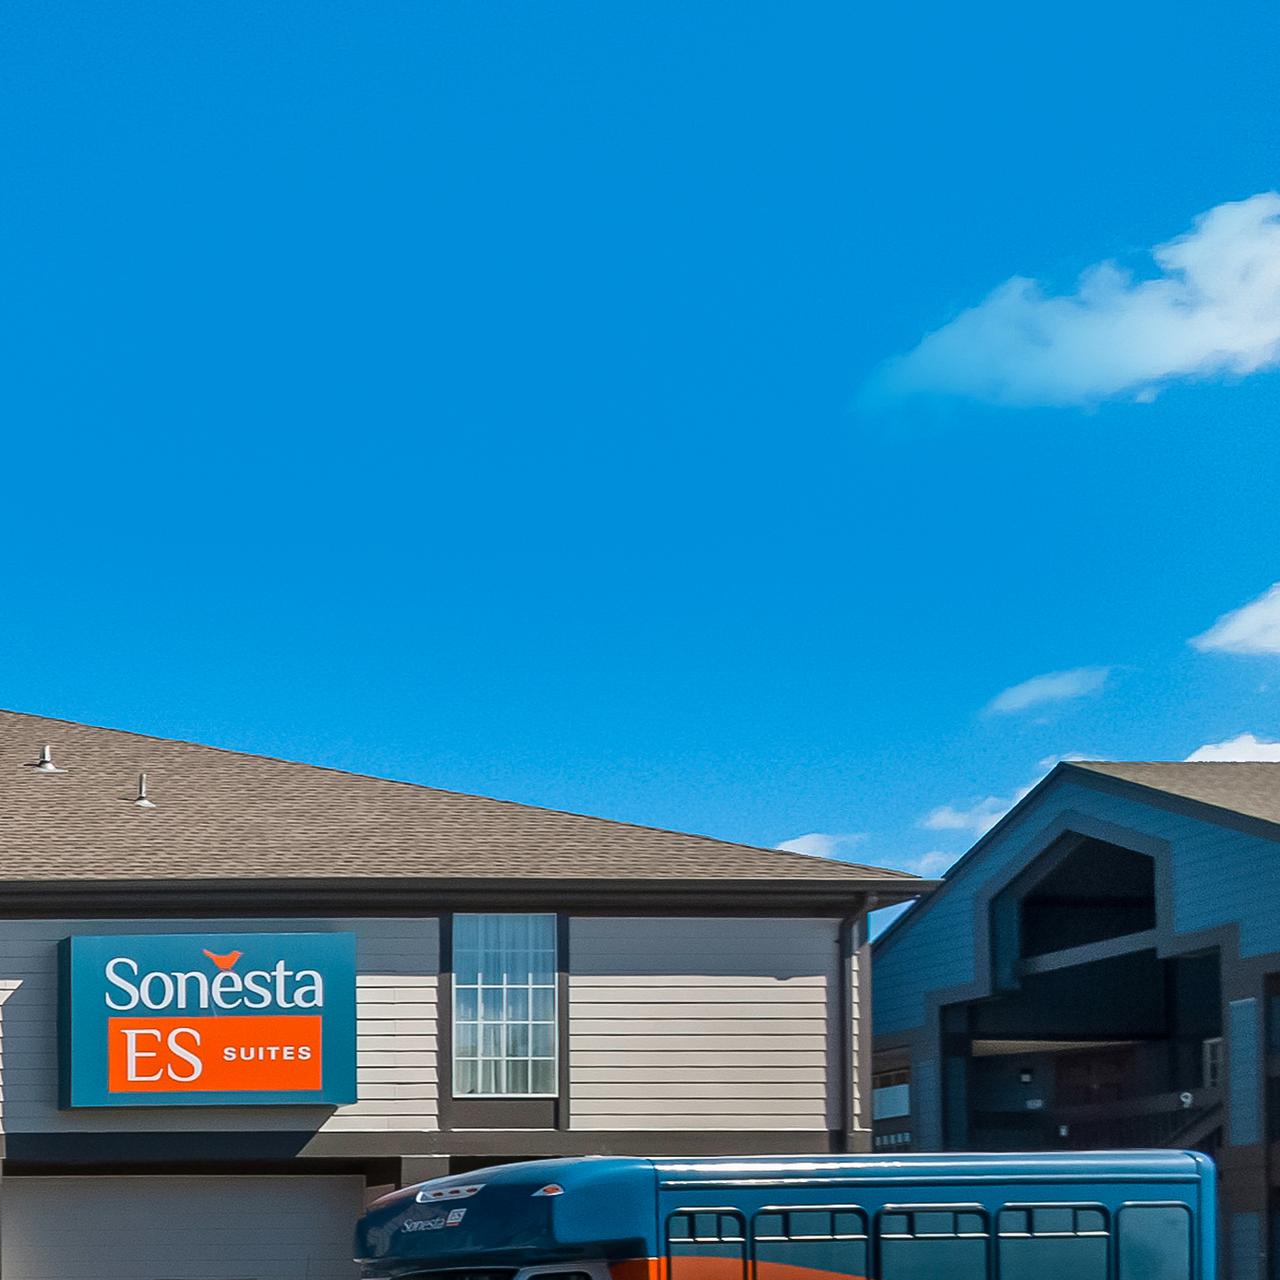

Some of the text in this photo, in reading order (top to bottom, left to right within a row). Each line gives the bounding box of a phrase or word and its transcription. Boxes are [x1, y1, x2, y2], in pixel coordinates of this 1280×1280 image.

[104, 956, 324, 1011] Sonesta
[120, 1027, 312, 1082] ES SUITES
